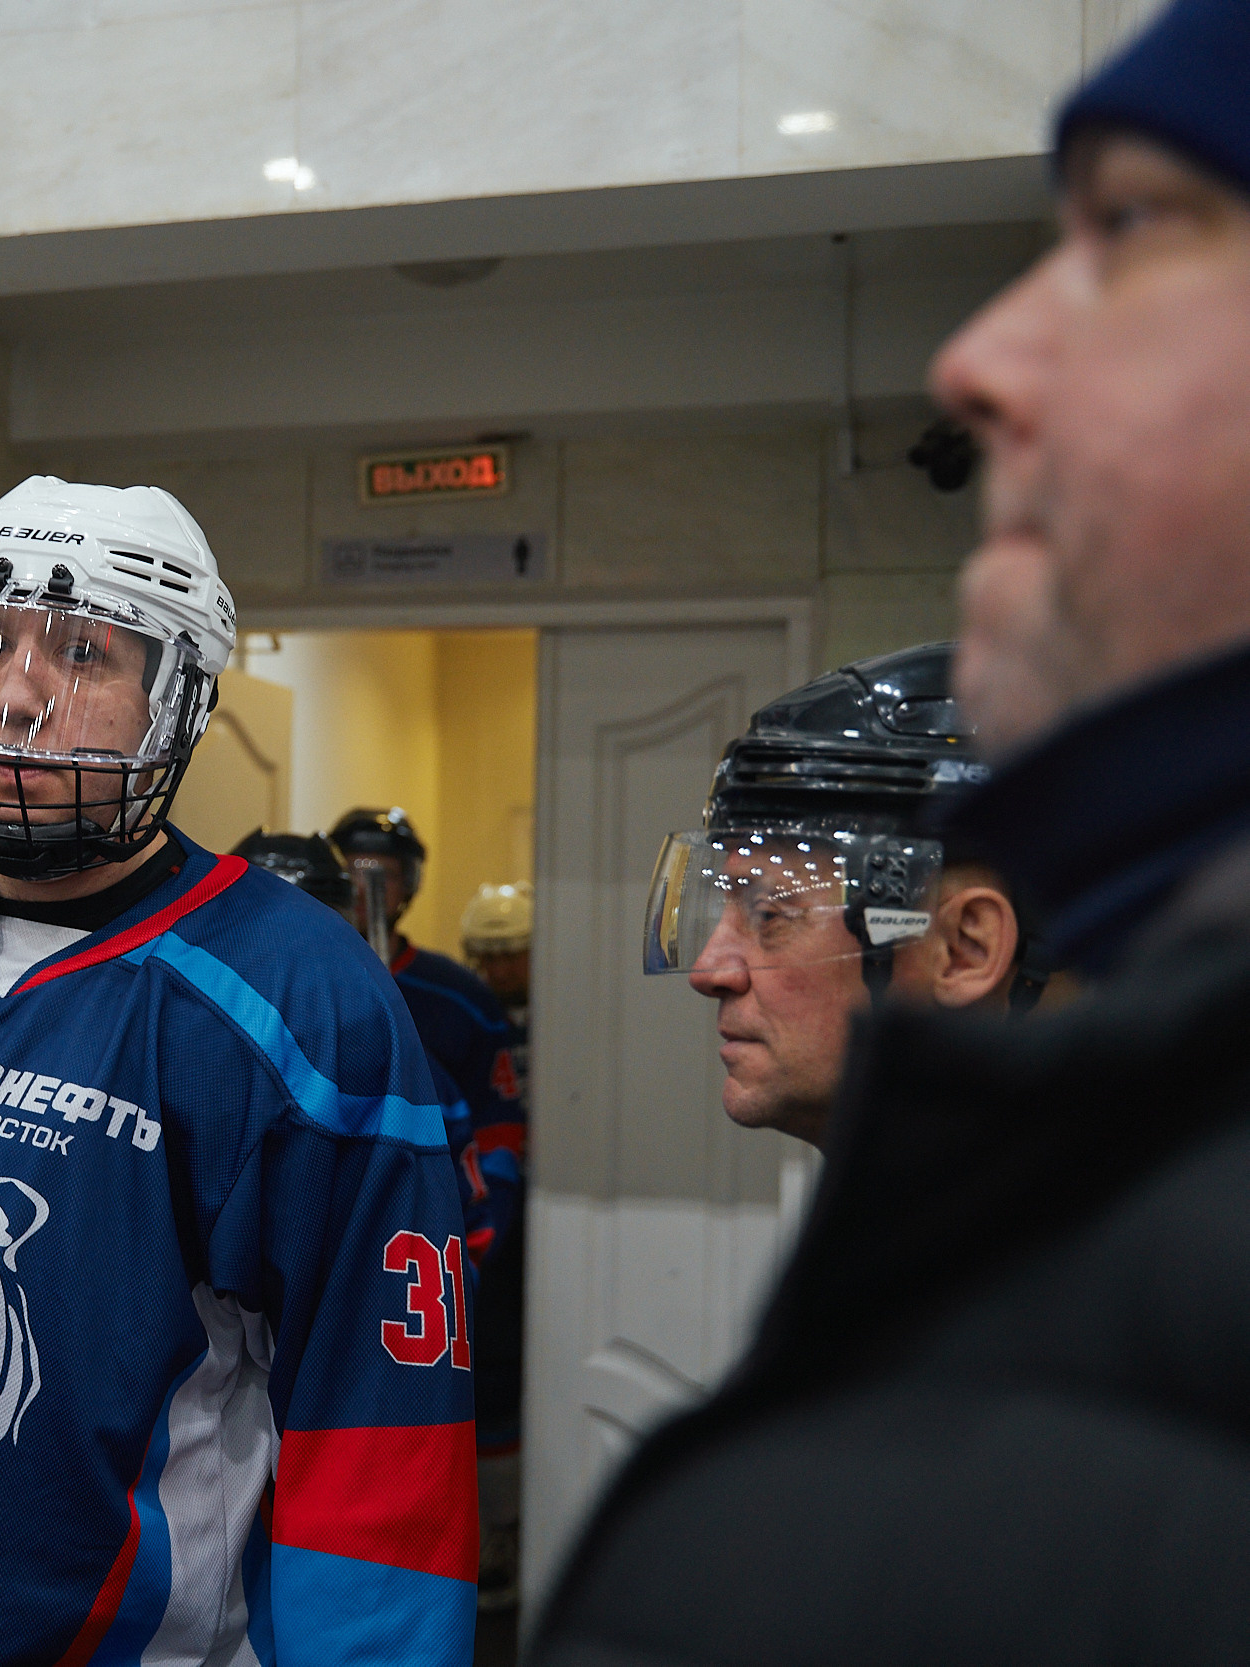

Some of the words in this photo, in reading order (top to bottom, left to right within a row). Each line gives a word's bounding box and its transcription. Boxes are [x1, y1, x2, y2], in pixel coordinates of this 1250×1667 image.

[372, 456, 501, 496] ВЫХОД
[869, 916, 928, 926] BAUER
[380, 1229, 471, 1371] 31
